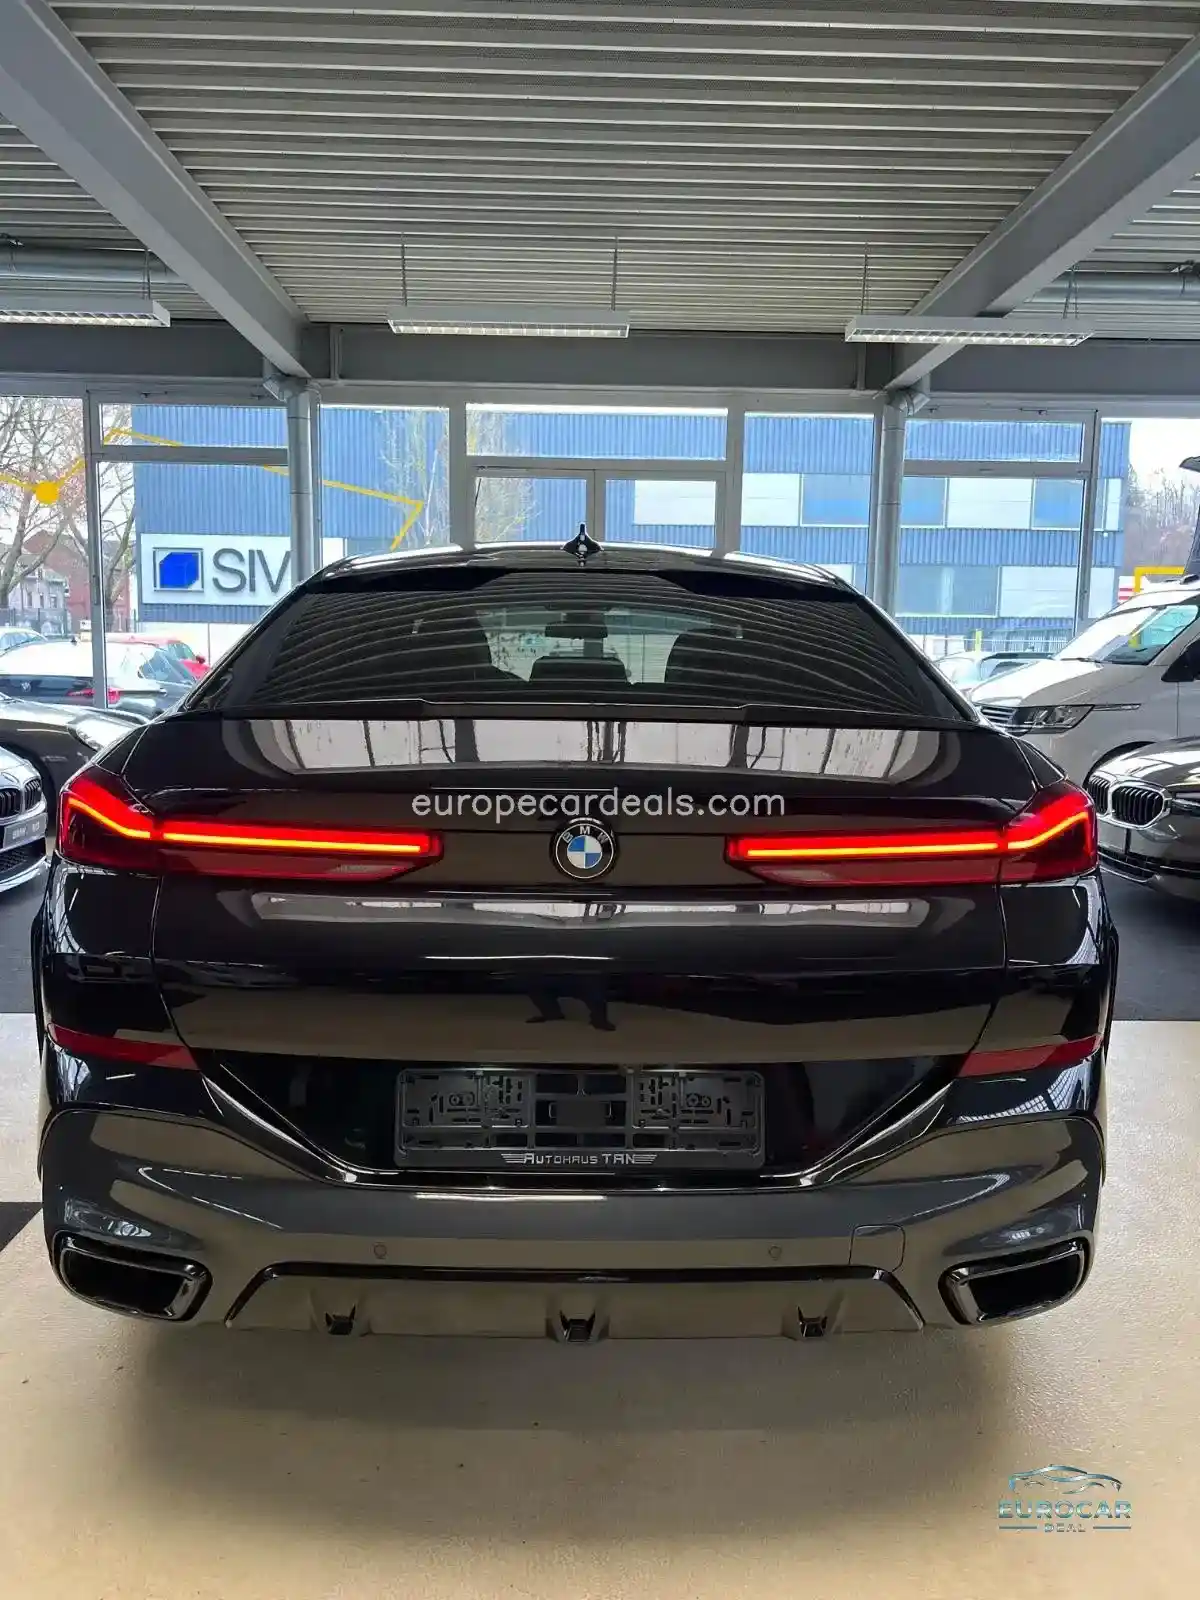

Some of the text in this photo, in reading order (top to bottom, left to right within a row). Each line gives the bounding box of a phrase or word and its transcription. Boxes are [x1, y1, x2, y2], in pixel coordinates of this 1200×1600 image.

[213, 548, 291, 593] SIV
[562, 825, 609, 844] BMW
[602, 1153, 635, 1165] TAN
